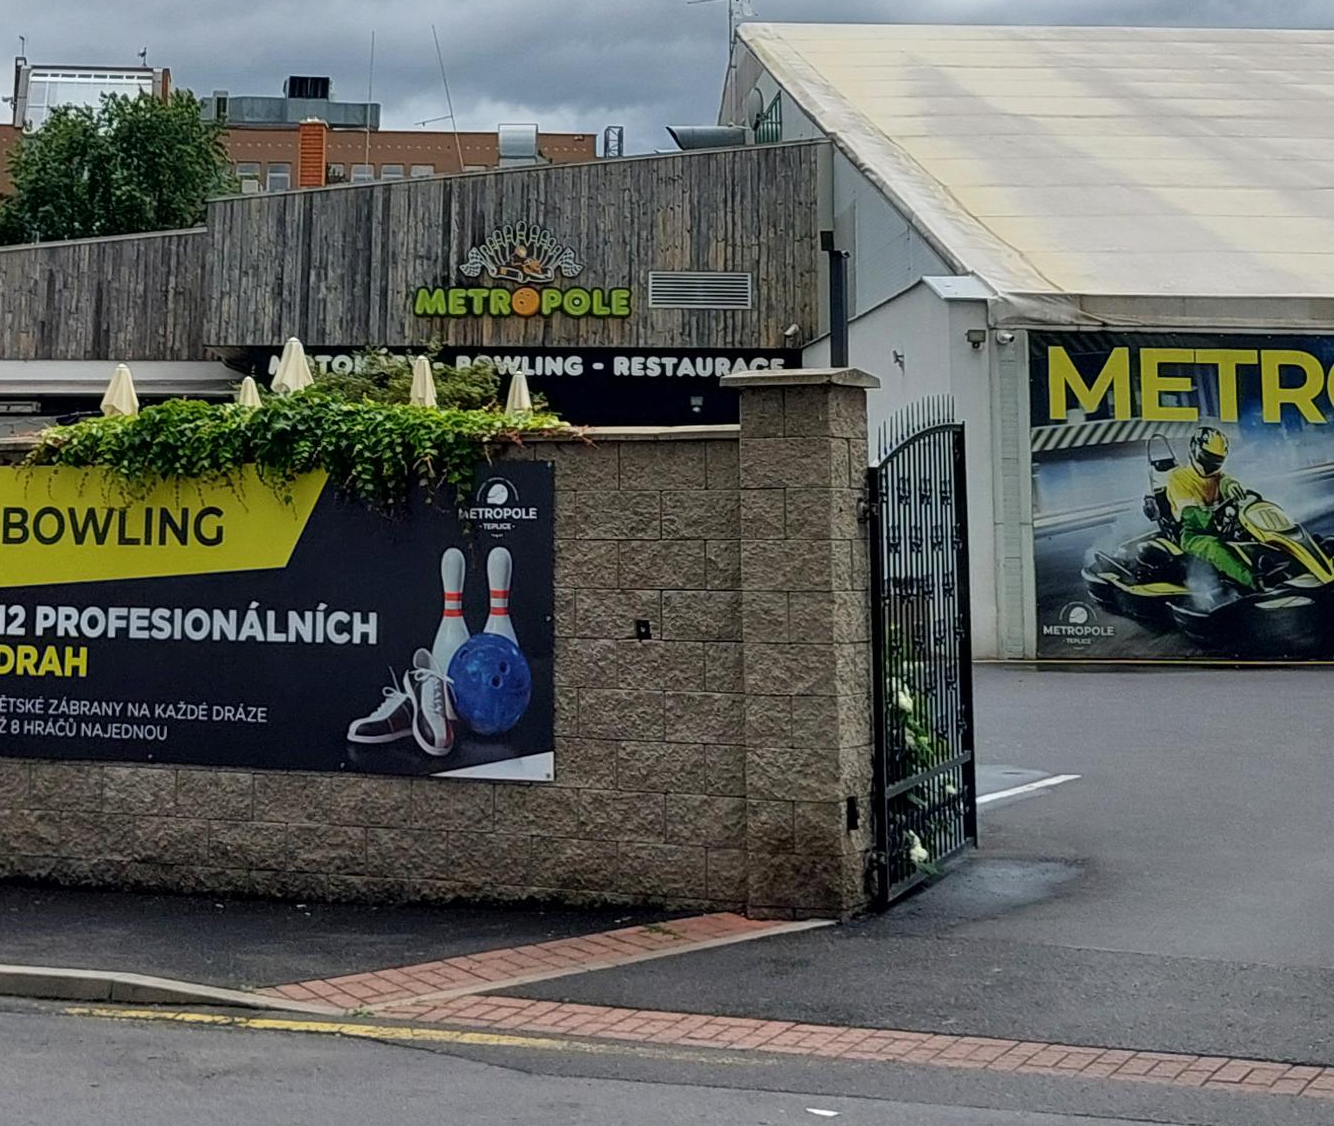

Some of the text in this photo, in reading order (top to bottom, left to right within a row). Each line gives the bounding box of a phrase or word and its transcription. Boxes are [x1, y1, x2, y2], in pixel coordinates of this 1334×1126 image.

[415, 287, 630, 316] METROPOLE
[458, 507, 537, 519] METROPOLE
[1, 507, 224, 546] BOWLING
[35, 601, 377, 644] PROFESIONÁLNÍCH
[1043, 625, 1115, 636] METROPOLE
[48, 698, 122, 717] ZÁBRANY
[127, 702, 151, 718] NA
[155, 701, 208, 720] KAŽDÉ
[213, 703, 268, 722] DRÁZE
[11, 722, 20, 734] 8
[24, 719, 77, 736] HRÁČŮ
[81, 723, 168, 741] NAJEDNOU
